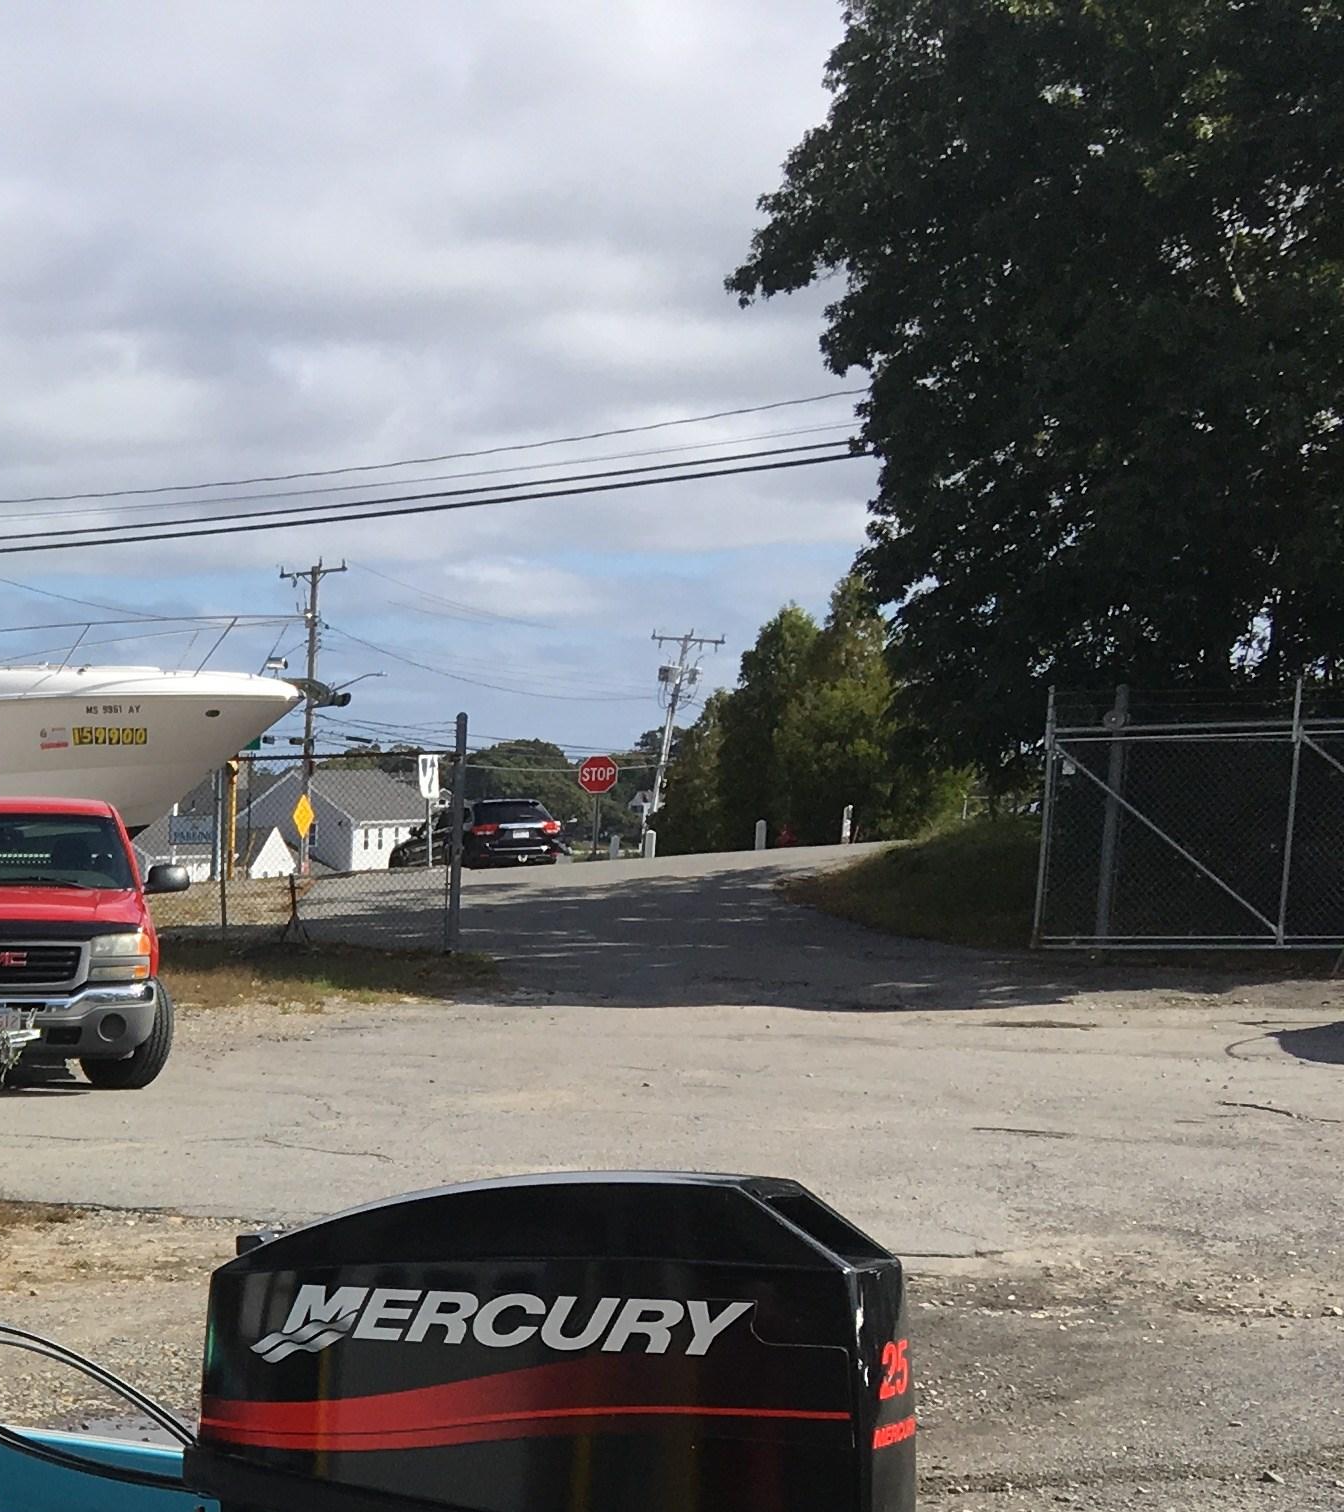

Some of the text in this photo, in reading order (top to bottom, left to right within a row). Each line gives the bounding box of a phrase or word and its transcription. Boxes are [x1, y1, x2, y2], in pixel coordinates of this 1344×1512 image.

[86, 705, 98, 715] MS
[127, 704, 142, 714] AY
[72, 726, 147, 746] 159900
[581, 766, 615, 782] STOP
[252, 1284, 755, 1358] MERCURY
[879, 1338, 909, 1400] 25
